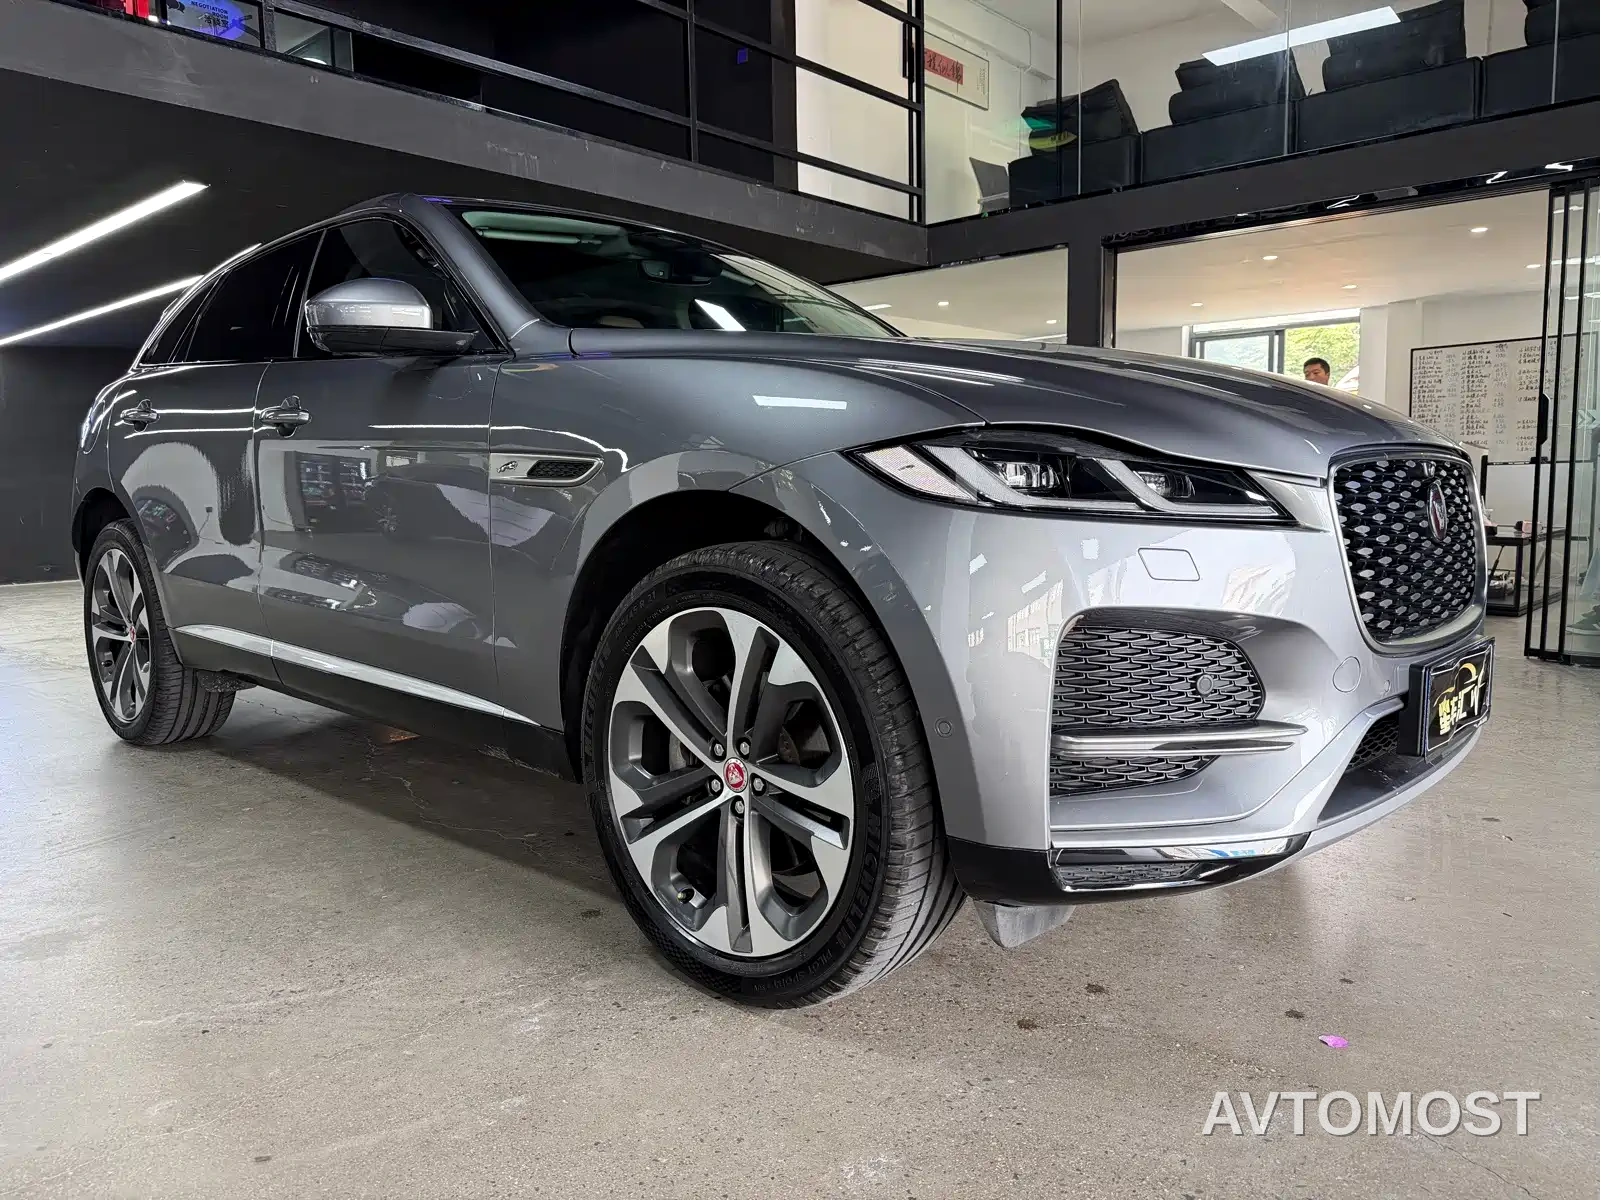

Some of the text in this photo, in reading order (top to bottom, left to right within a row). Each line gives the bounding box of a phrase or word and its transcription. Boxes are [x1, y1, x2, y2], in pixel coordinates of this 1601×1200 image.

[191, 1, 228, 14] NEGOTIATION
[212, 11, 229, 20] ROOM
[836, 811, 881, 949] MICHELIN
[807, 948, 833, 976] PILOT
